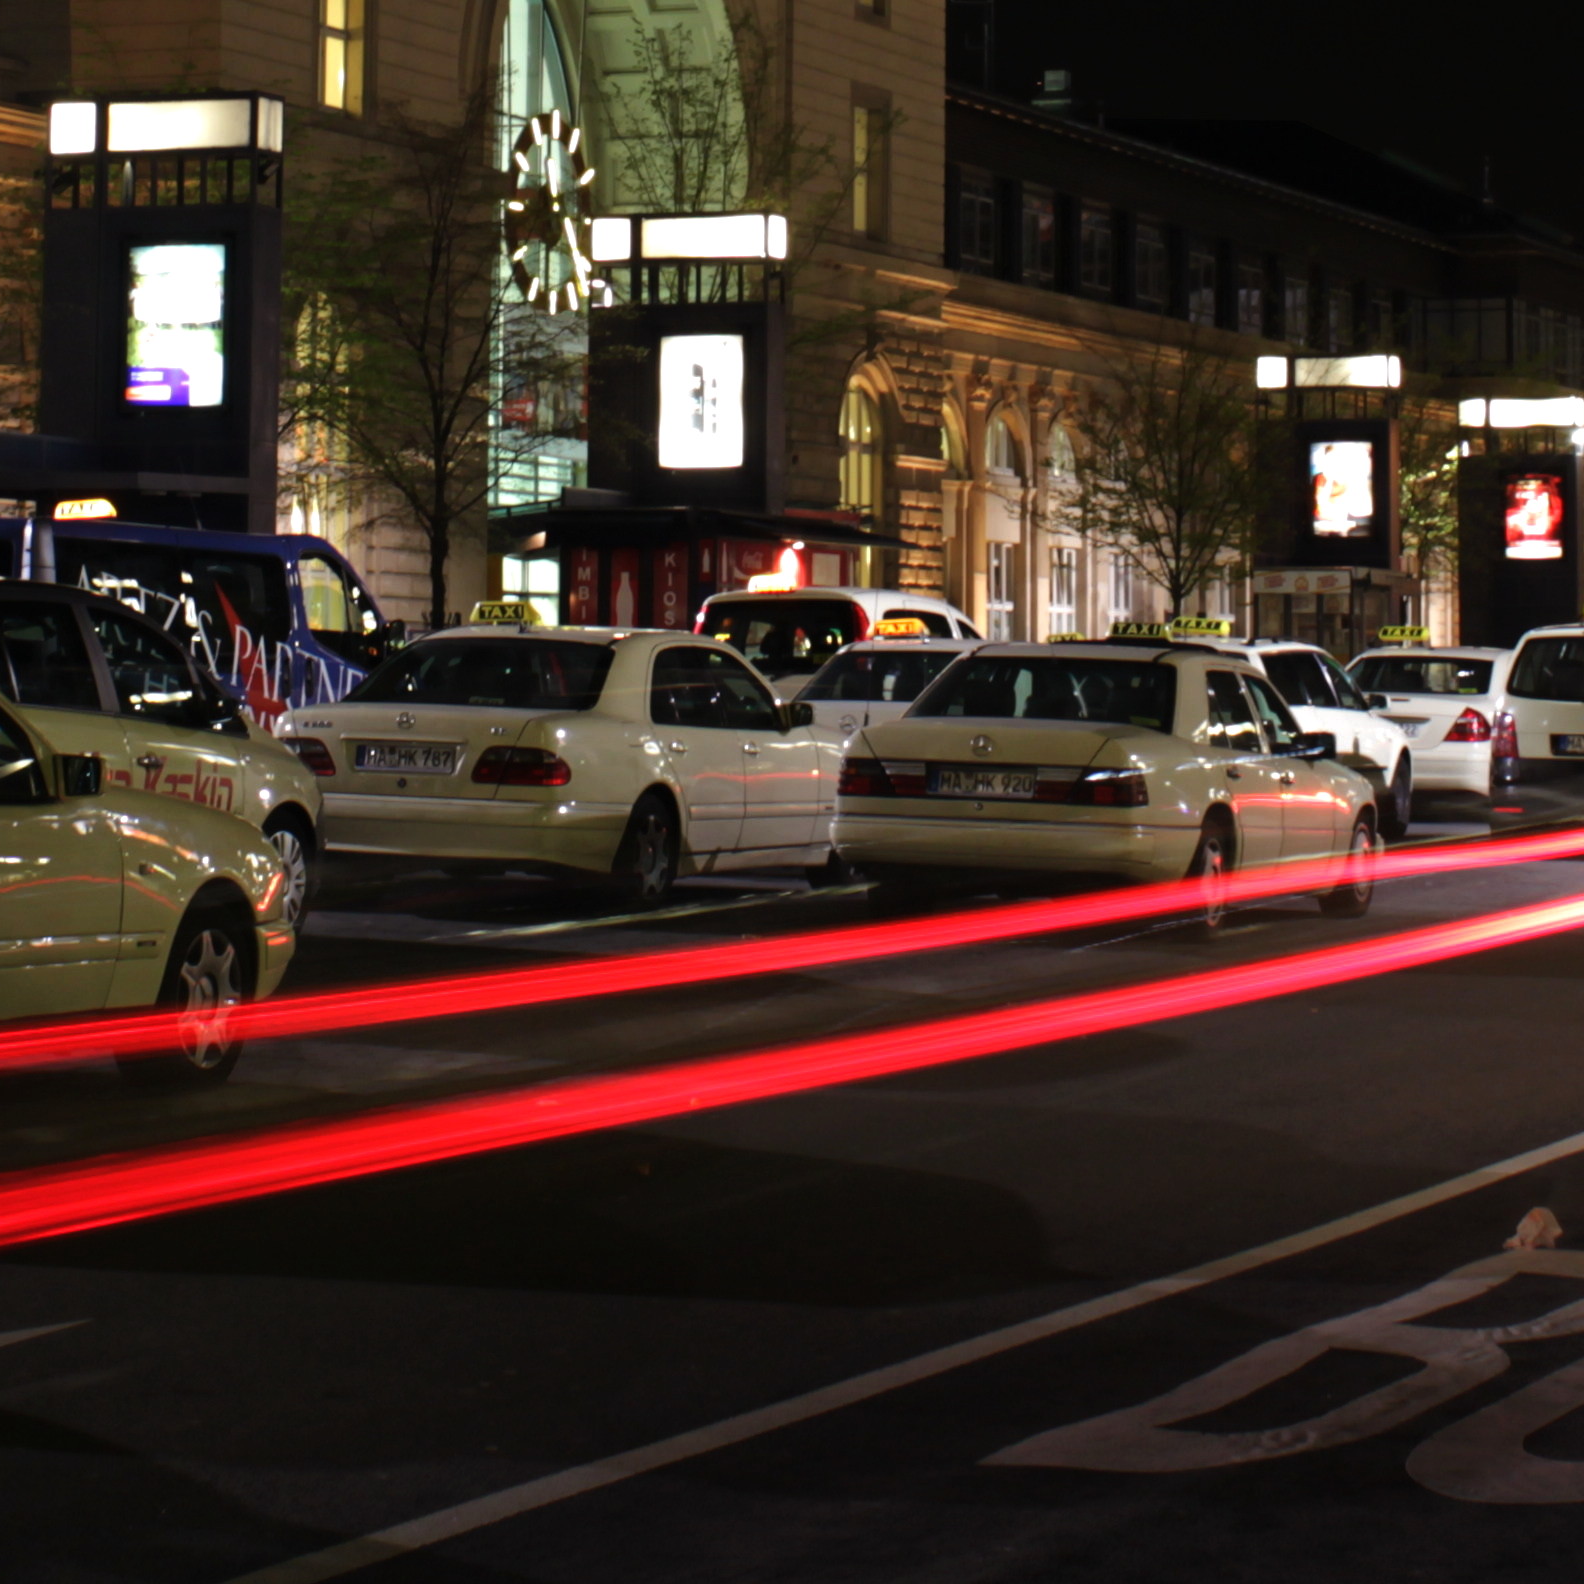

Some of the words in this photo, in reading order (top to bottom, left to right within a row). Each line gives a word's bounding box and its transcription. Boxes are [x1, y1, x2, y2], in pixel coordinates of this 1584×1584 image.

[481, 605, 523, 618] TAXI
[878, 622, 913, 634] TAXI
[1117, 623, 1158, 635] TAXI
[1179, 619, 1216, 629] TAXI
[1387, 628, 1419, 636] TAXI
[1001, 773, 1033, 793] 920
